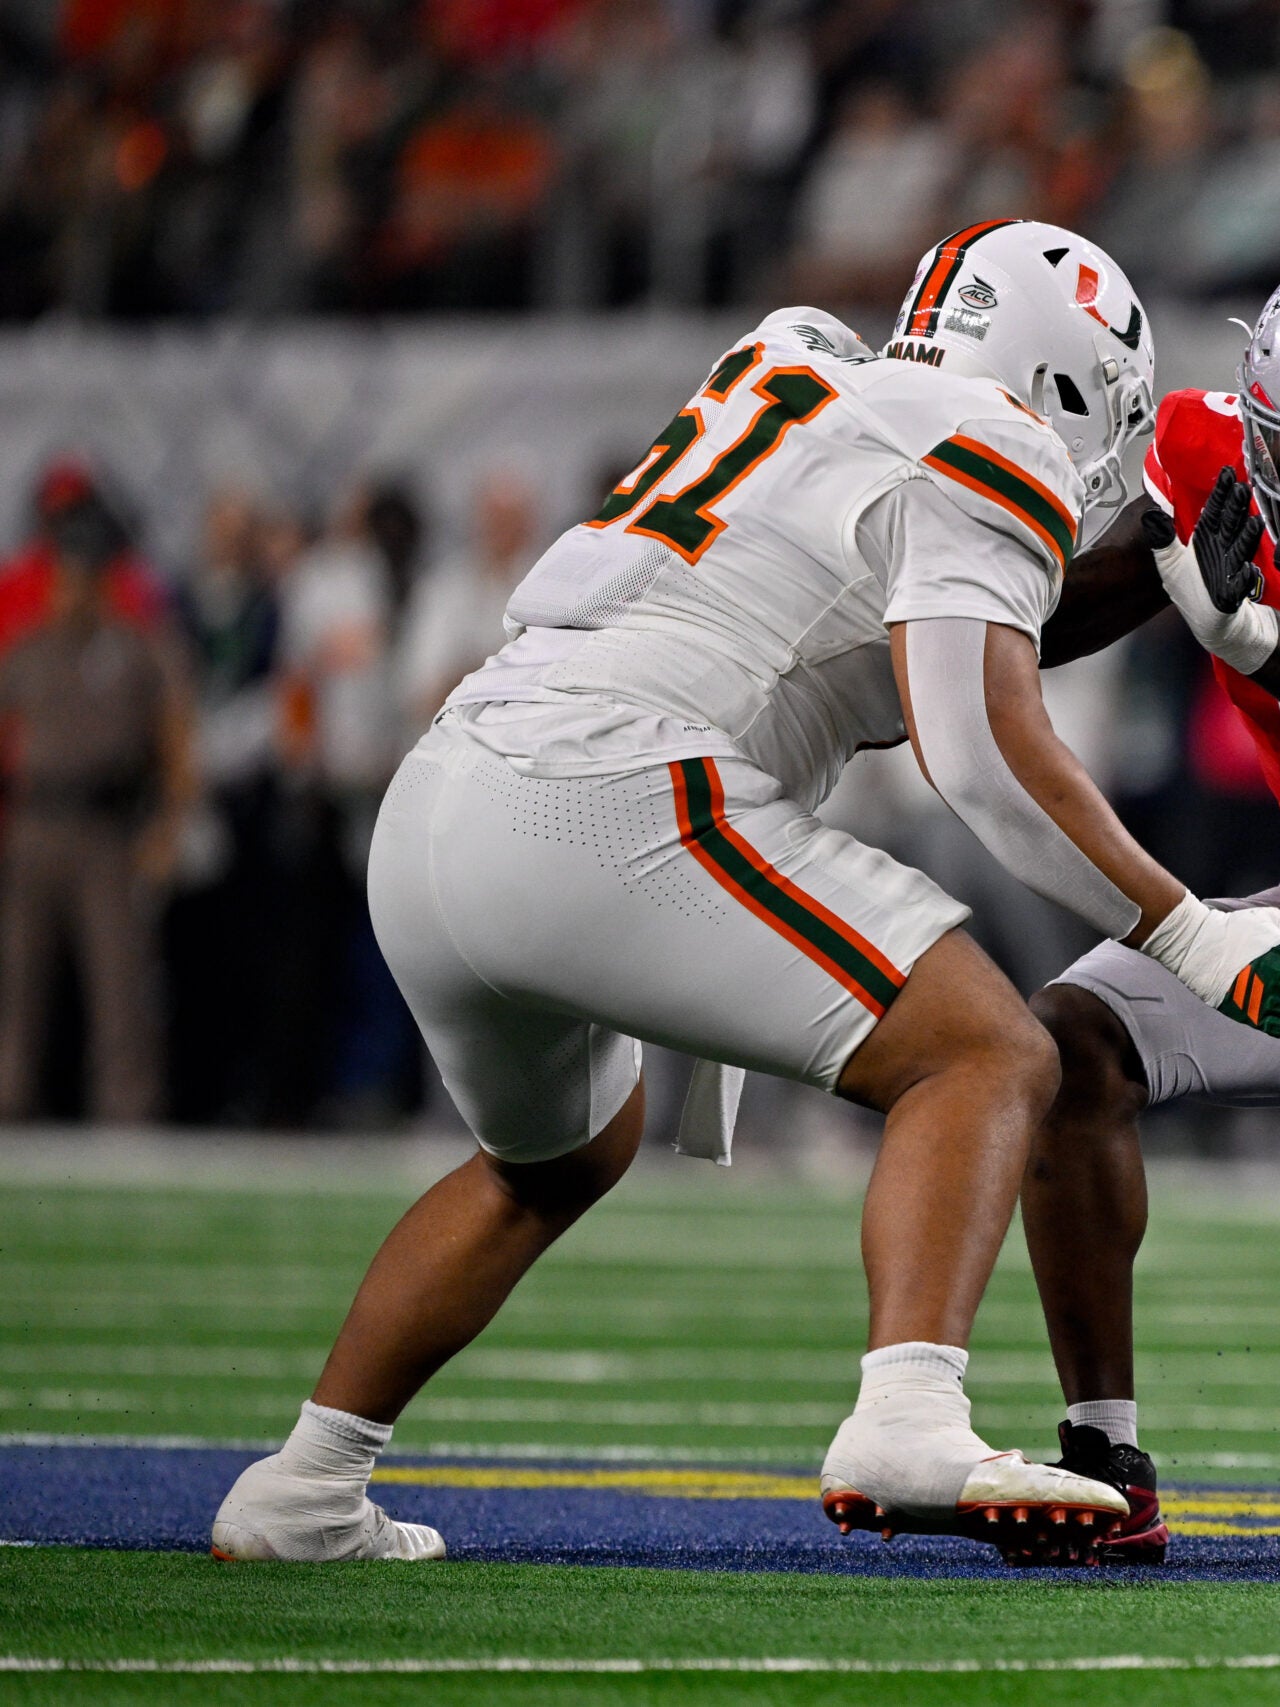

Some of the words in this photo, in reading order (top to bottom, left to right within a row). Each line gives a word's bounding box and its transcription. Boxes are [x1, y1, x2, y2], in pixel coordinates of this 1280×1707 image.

[964, 289, 993, 304] ACC
[887, 342, 946, 368] MIAMI
[582, 341, 840, 566] 61
